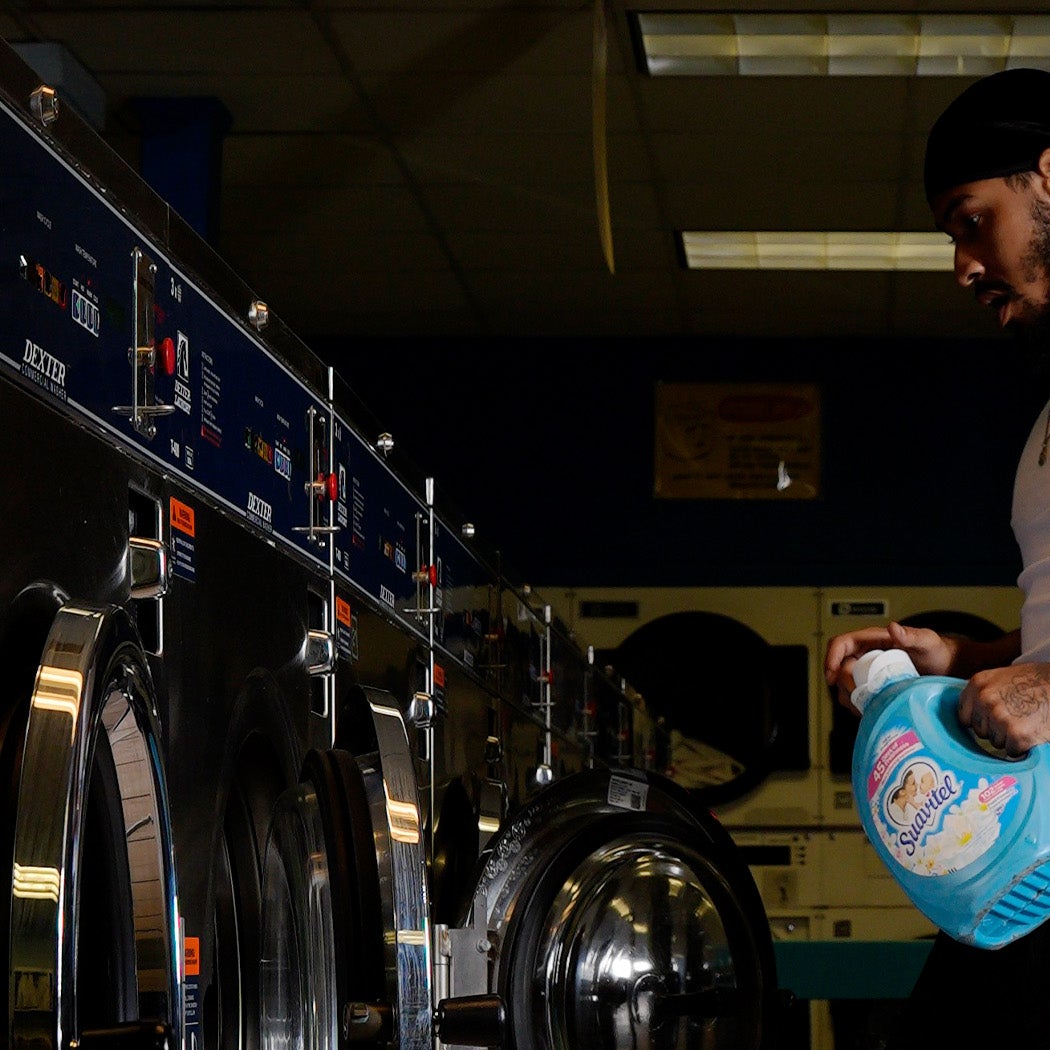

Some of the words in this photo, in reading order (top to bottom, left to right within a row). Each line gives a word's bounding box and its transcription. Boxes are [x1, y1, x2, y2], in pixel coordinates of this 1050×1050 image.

[23, 338, 66, 387] DEXTER
[247, 491, 272, 523] DEXTER
[872, 761, 886, 782] 45
[899, 775, 956, 857] Suavitel
